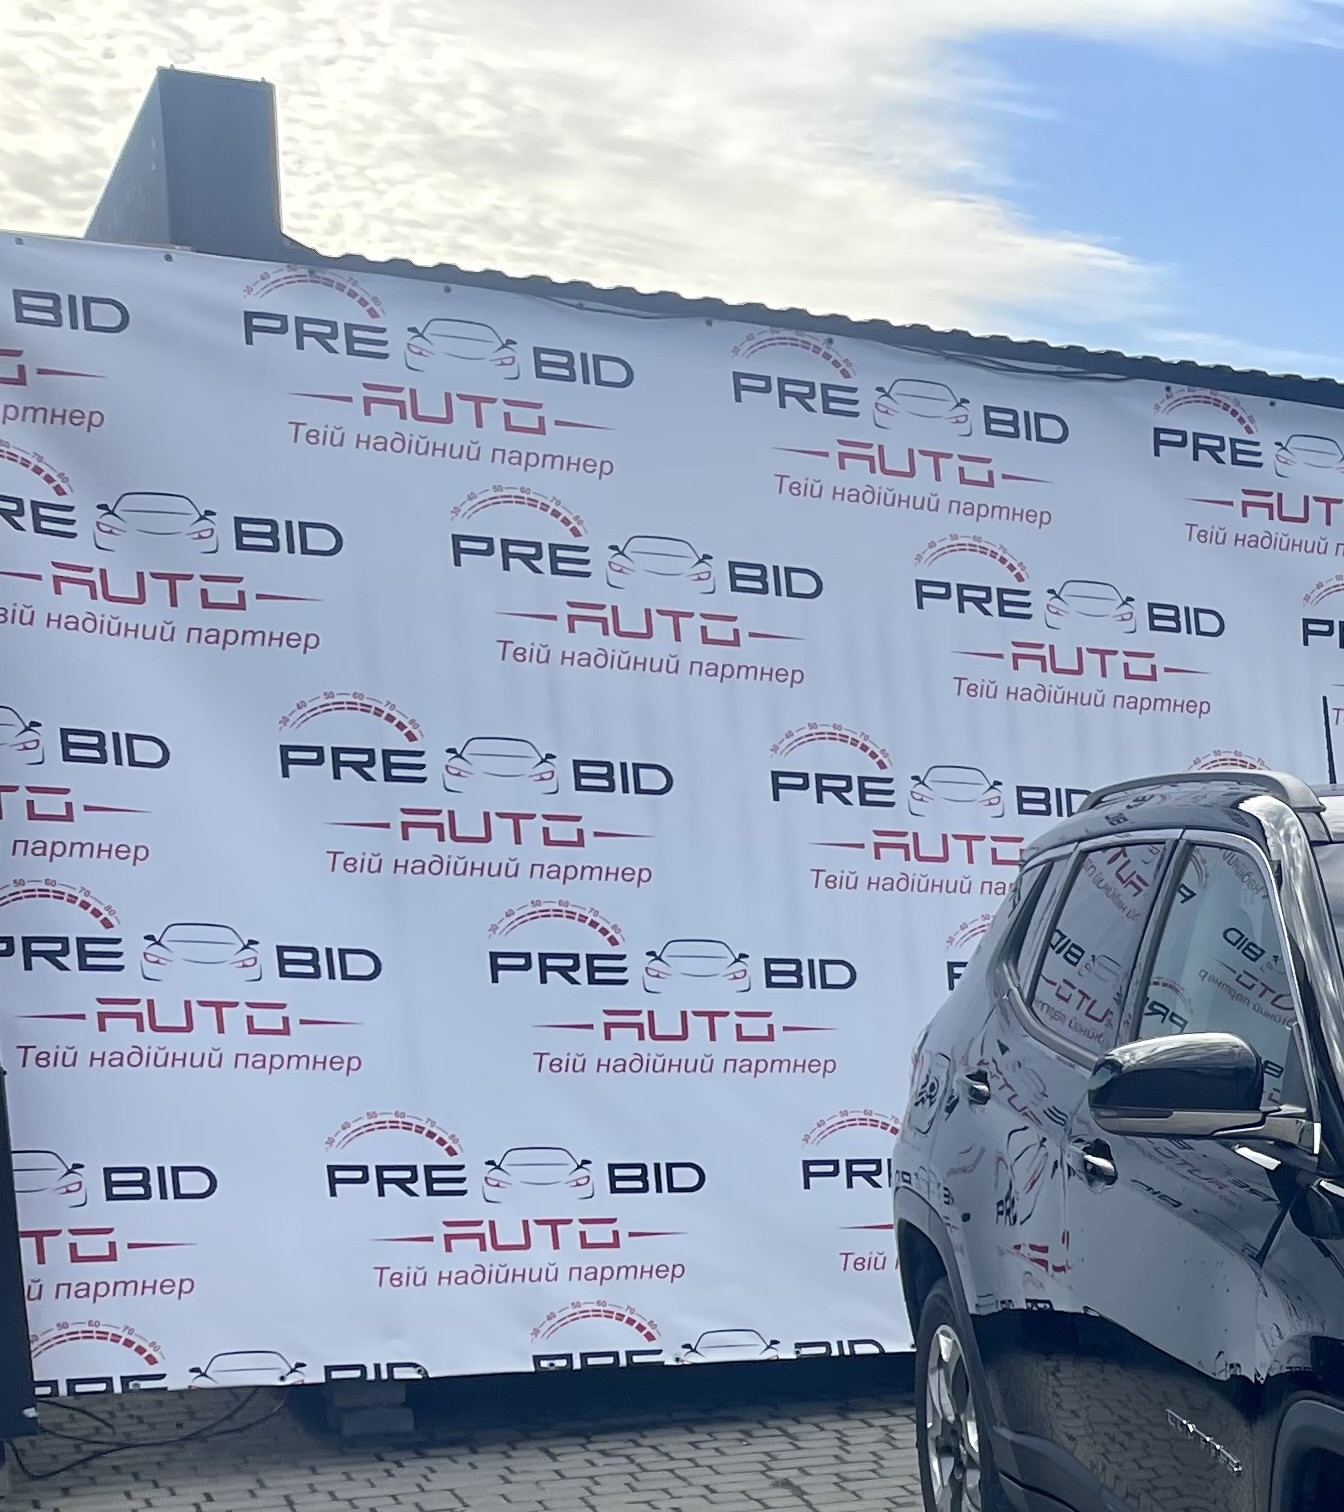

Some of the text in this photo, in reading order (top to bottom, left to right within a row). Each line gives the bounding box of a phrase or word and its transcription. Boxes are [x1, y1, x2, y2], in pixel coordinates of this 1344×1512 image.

[12, 289, 130, 333] BID
[243, 308, 634, 388] PRE BID
[362, 382, 546, 437] AUTO
[732, 369, 1069, 444] PRE BID
[288, 422, 613, 480] Твій надійний партнер
[836, 439, 995, 489] AUTO
[1153, 424, 1263, 468] PRE
[774, 474, 1051, 529] Твій надійний партнер
[234, 516, 343, 556] BID
[1185, 523, 1227, 545] Твій
[1234, 531, 1328, 555] надійний
[451, 530, 823, 599] PRE BID
[51, 561, 246, 611] AUTO
[566, 601, 741, 650] AUTO
[915, 579, 1225, 637] PRE BID
[0, 603, 319, 654] вій надійний партнер
[496, 640, 804, 688] Твій надійний партнер
[1011, 641, 1157, 682] AUTO
[352, 692, 364, 700] 60
[384, 700, 396, 711] 70
[953, 677, 1210, 719] Твій надійний партнер
[60, 727, 170, 768] BID
[280, 744, 673, 795] PRE BID
[771, 770, 896, 807] PRE
[400, 808, 585, 848] AUTO
[12, 840, 149, 866] партнер
[873, 829, 1024, 866] AUTO
[326, 851, 652, 888] Твій надійний партнер
[810, 869, 858, 890] Твій
[867, 872, 972, 894] надійний
[79, 886, 91, 897] 70
[276, 945, 382, 981] BID
[489, 951, 857, 989] PRE BID
[96, 998, 291, 1036] AUTO
[603, 1009, 775, 1042] AUTO
[16, 1045, 361, 1077] Твій надійний партнер
[533, 1052, 836, 1078] Твій надійний партнер
[103, 1166, 217, 1201] BID
[327, 1162, 705, 1197] PRE BID
[802, 1158, 892, 1189] PR
[20, 1228, 118, 1265] TO
[443, 1218, 620, 1253] AUTO
[373, 1263, 685, 1287] Твій надійний партнер
[839, 1251, 886, 1271] Твій
[55, 1278, 194, 1304] партнер
